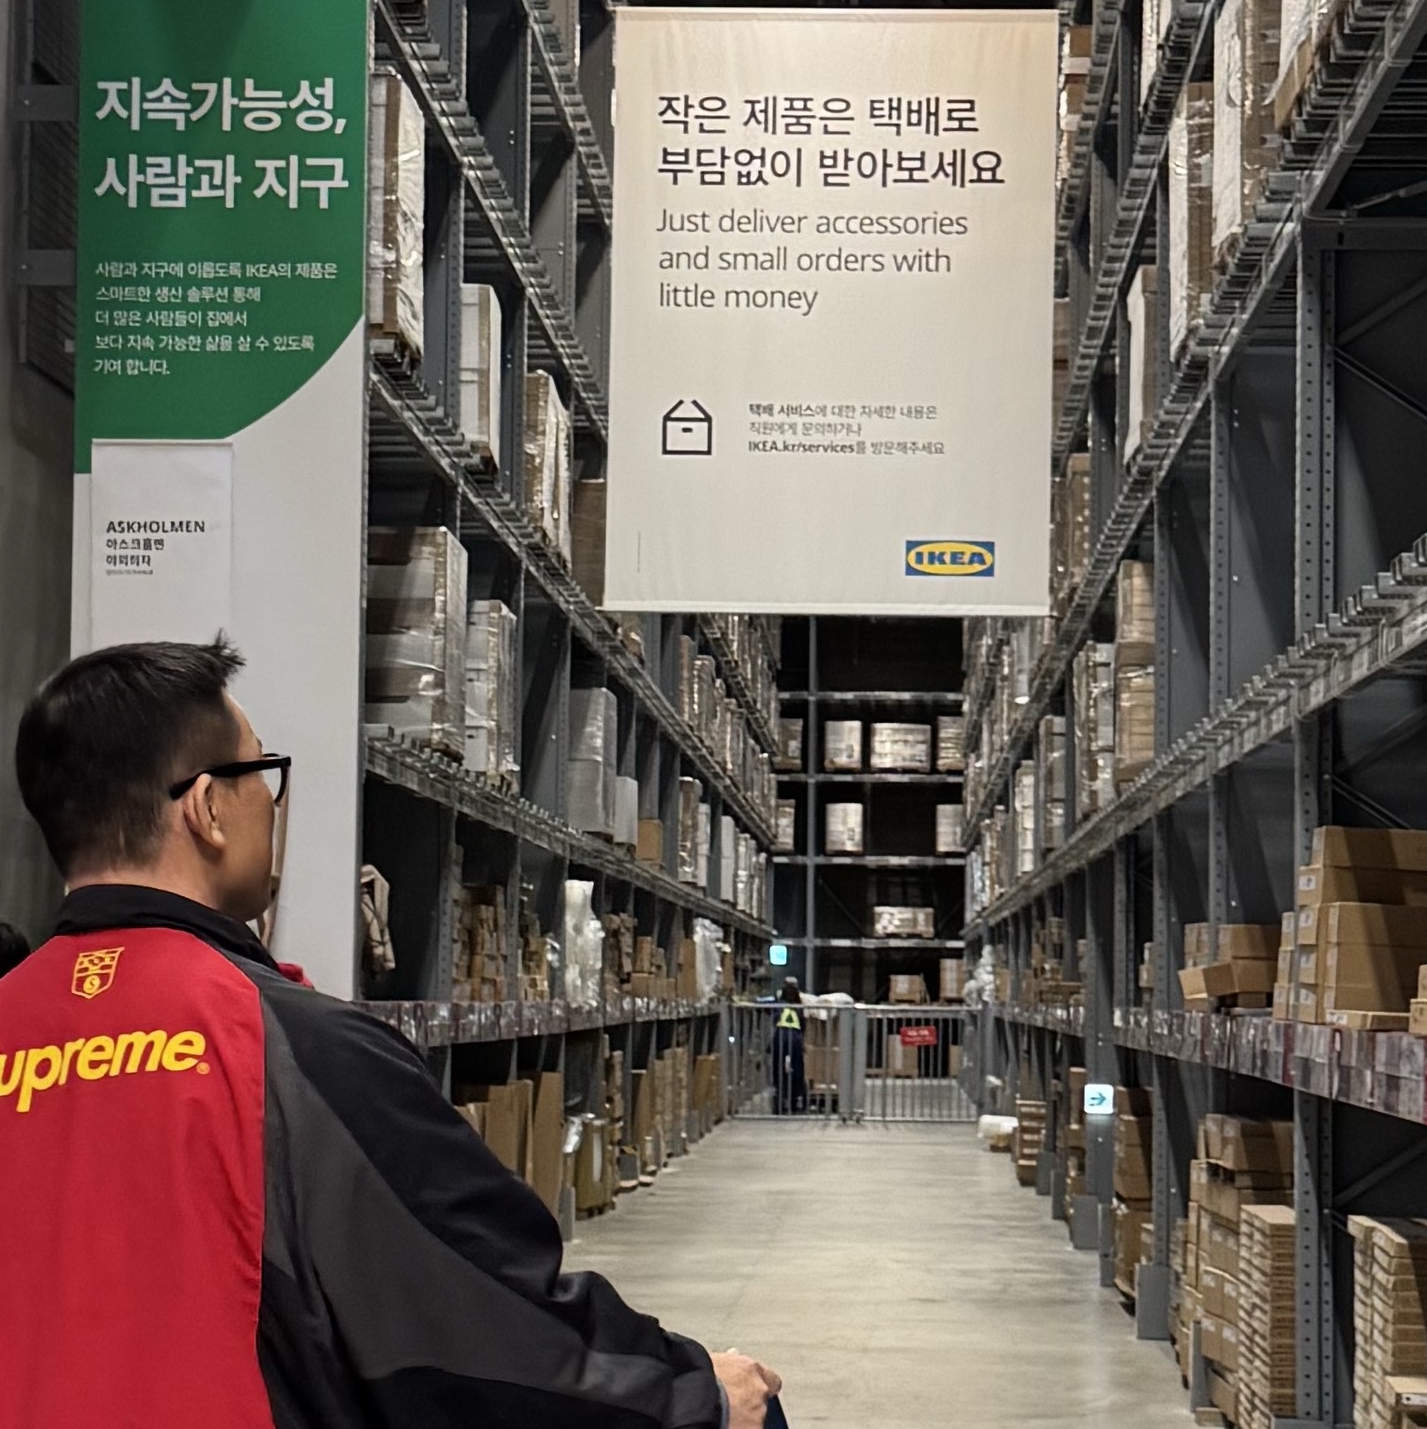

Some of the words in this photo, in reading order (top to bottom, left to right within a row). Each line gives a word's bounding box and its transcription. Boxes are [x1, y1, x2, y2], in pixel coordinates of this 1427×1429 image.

[95, 77, 348, 134] 지속가능성,
[657, 94, 731, 134] 작은
[742, 95, 855, 136] 제품은
[869, 96, 979, 136] 택배로
[657, 146, 803, 187] 부담없이
[818, 147, 1005, 188] 받아보세요
[94, 153, 242, 209] 사람과
[253, 154, 350, 209] 지구
[656, 208, 711, 233] Just
[718, 208, 808, 234] deliver
[815, 211, 969, 235] accessories
[659, 245, 710, 271] and
[718, 246, 788, 272] small
[796, 247, 886, 273] orders
[893, 248, 951, 273] with
[95, 262, 137, 278] 사람과
[142, 262, 183, 278] 지구에
[246, 262, 291, 278] IKEA의
[96, 286, 150, 302] 스마트한
[155, 286, 182, 302] 생산
[659, 282, 715, 308] little
[724, 289, 818, 316] money
[95, 311, 109, 326] 더
[146, 311, 202, 327] 사람들이
[206, 311, 248, 327] 집에서
[95, 335, 123, 350] 보다
[127, 335, 154, 351] 지속
[159, 335, 201, 352] 가능한
[255, 336, 270, 351] 수
[273, 336, 315, 352] 있도록
[94, 359, 121, 375] 기여
[126, 359, 171, 375] 합니다.
[749, 403, 775, 417] 택배
[777, 404, 828, 418] 서비스에
[106, 520, 206, 534] ASKHOLMEN
[914, 551, 988, 566] IKEA
